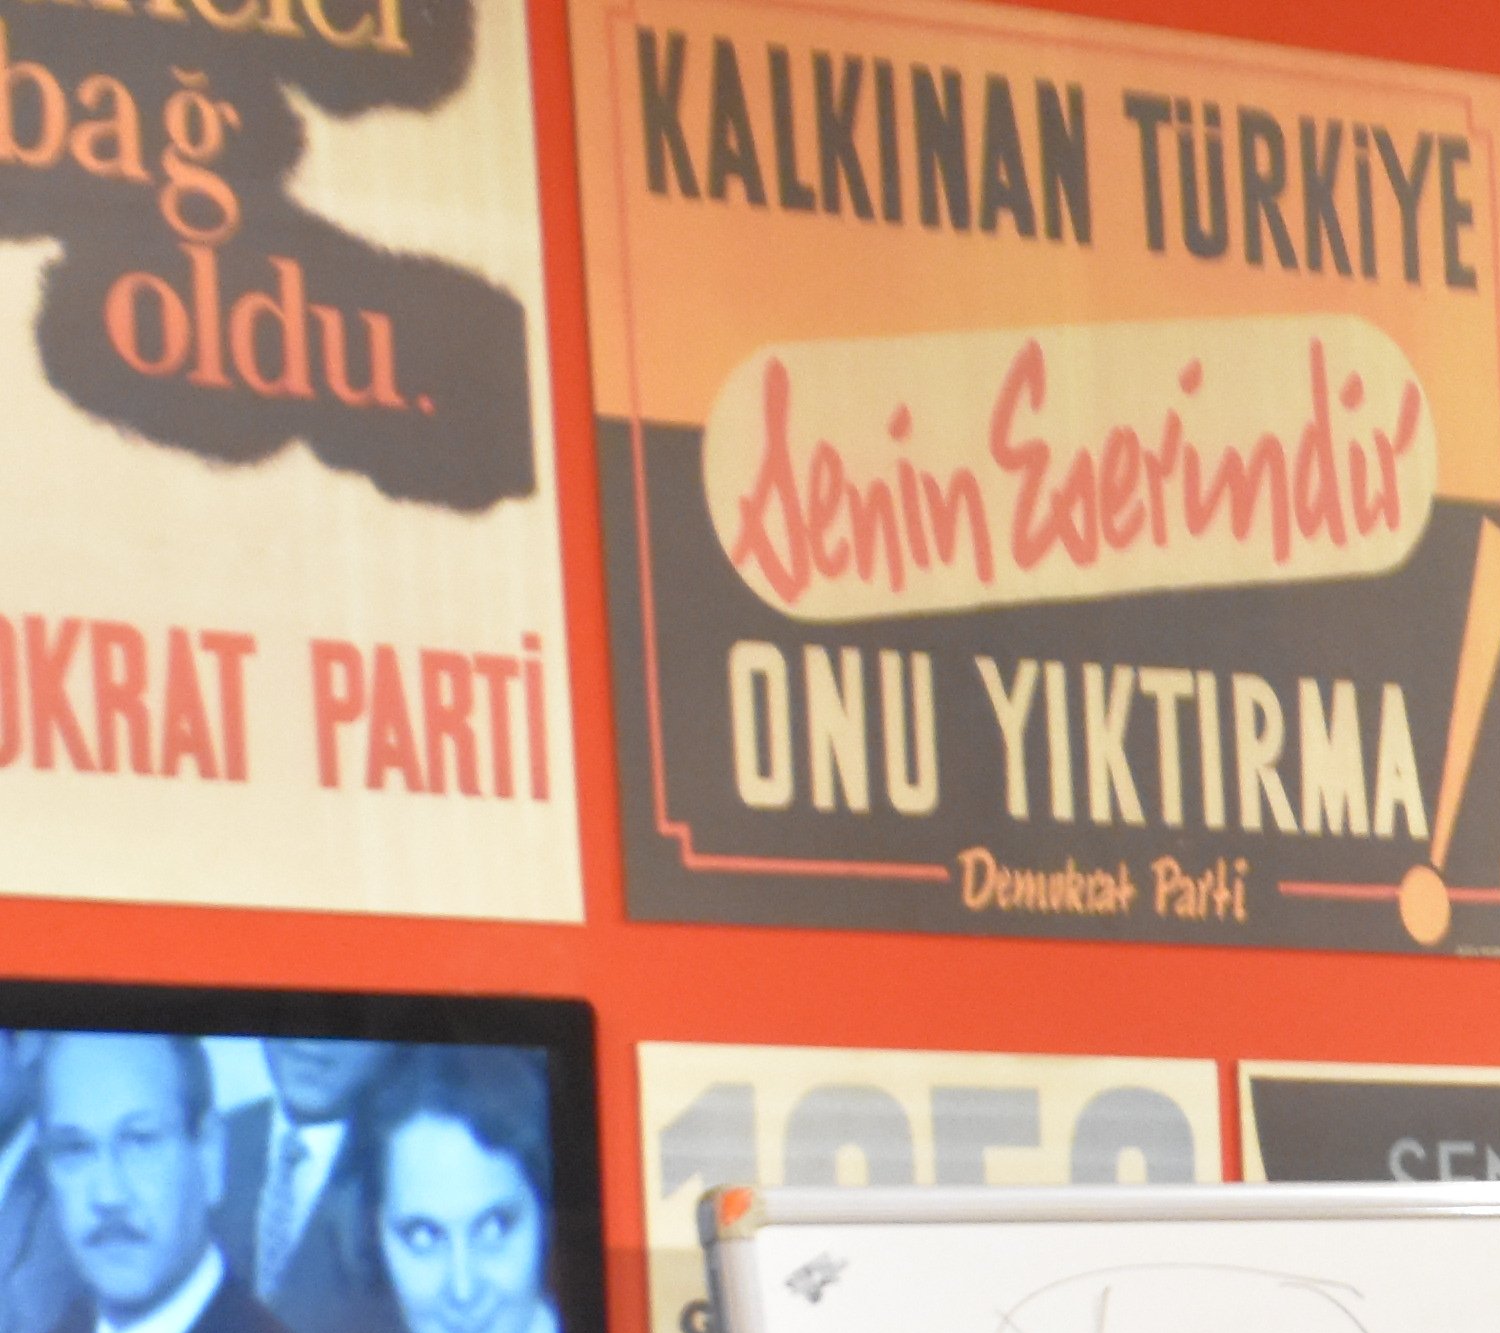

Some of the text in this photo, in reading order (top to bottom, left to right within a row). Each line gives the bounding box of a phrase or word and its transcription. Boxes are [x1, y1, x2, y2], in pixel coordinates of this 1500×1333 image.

[636, 26, 1479, 290] KALKINAN TÜRKİYE
[104, 243, 434, 414] oldu.
[310, 633, 551, 803] PARTİ
[729, 641, 938, 815] ONU
[958, 848, 1249, 922] Demokrat Parti
